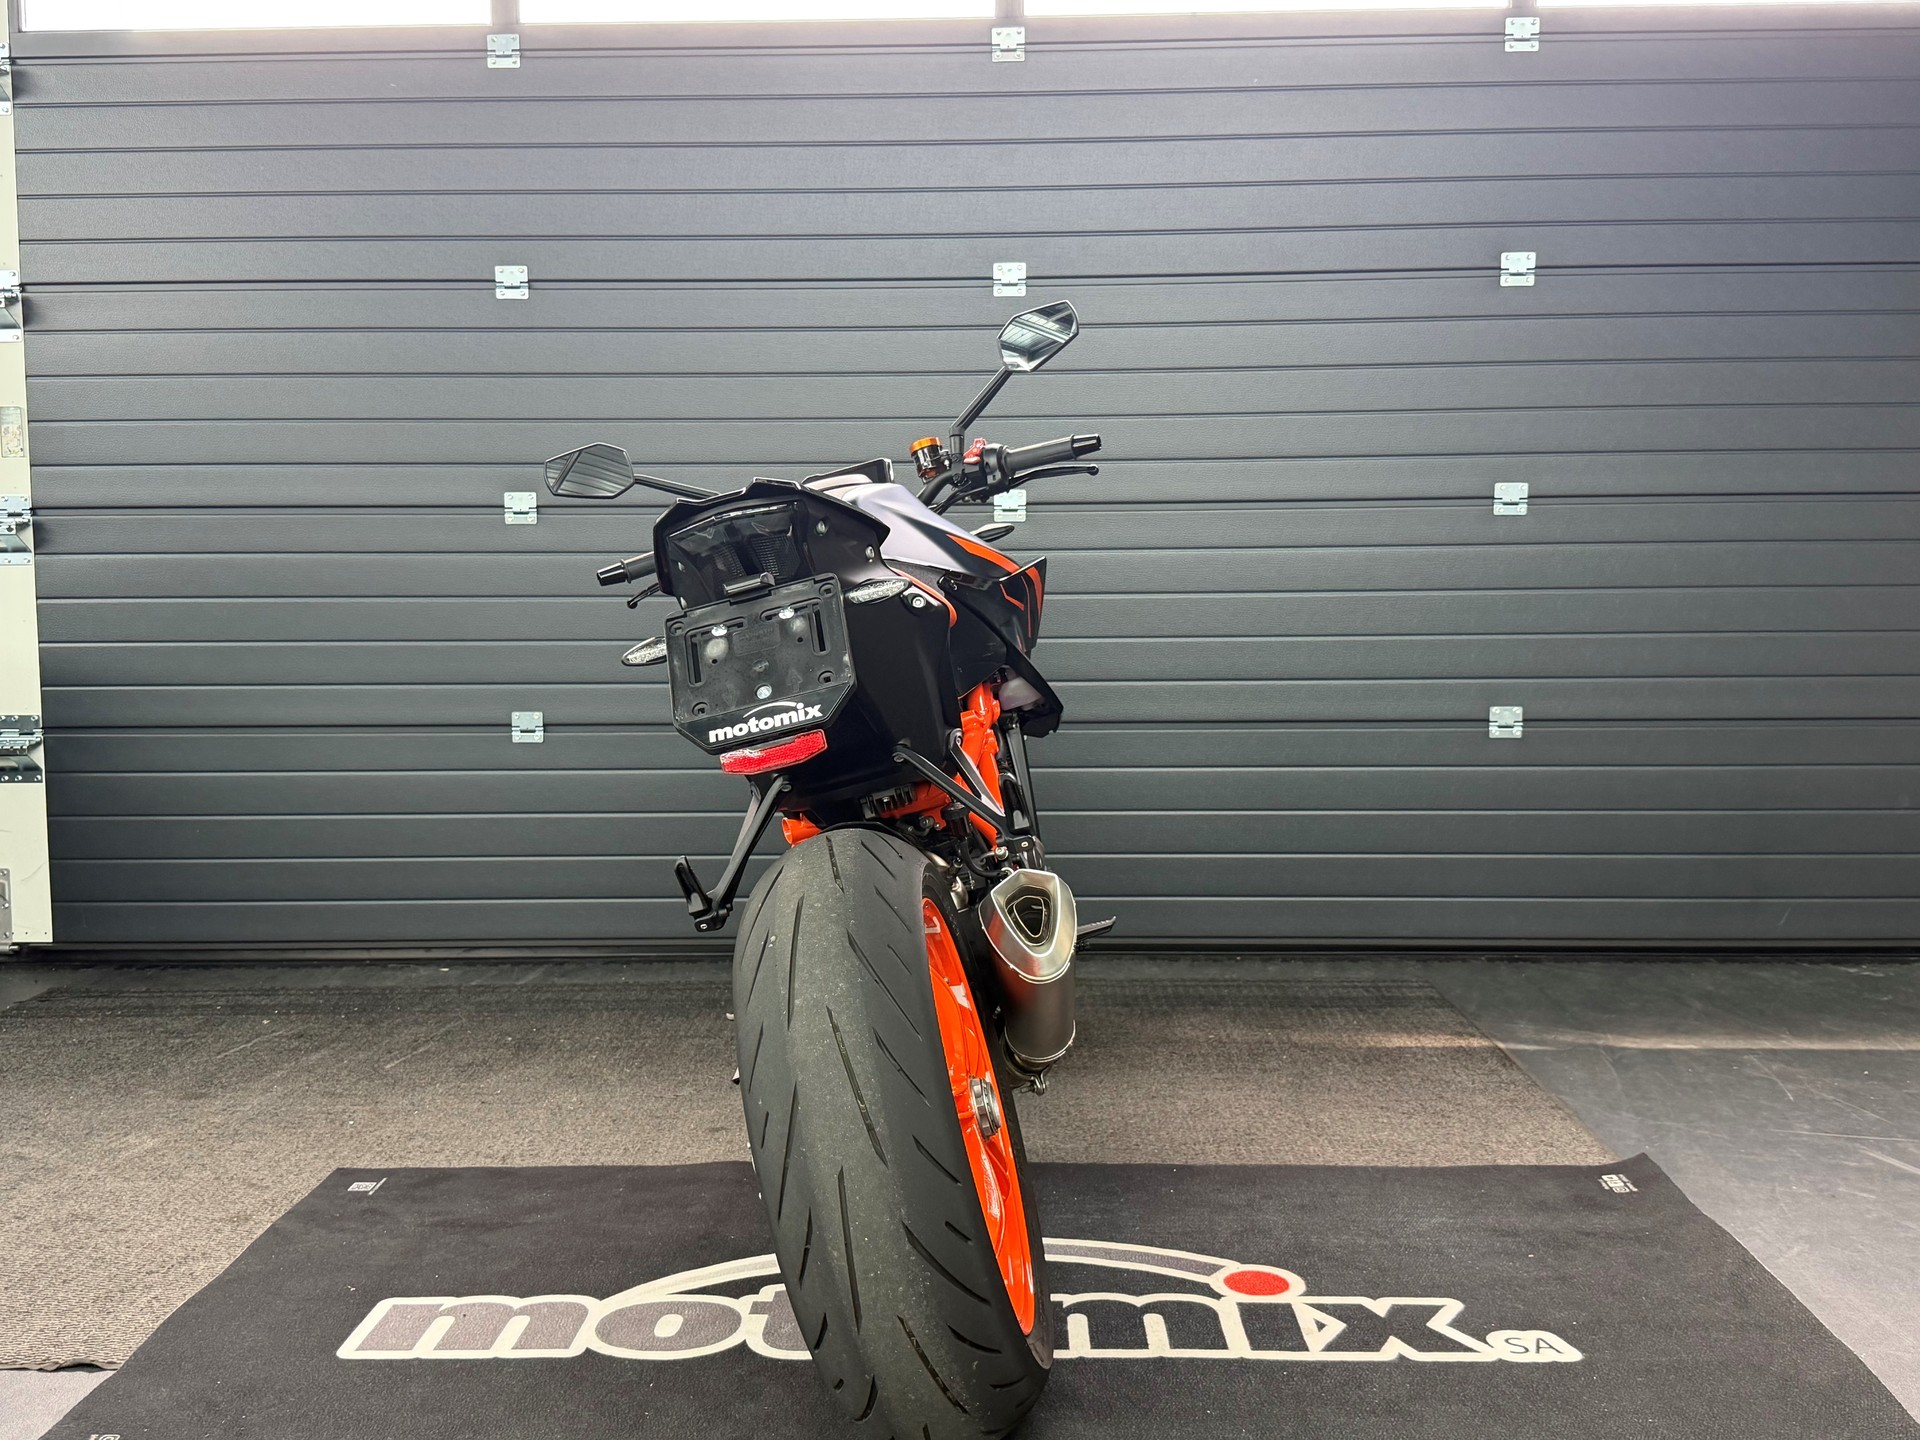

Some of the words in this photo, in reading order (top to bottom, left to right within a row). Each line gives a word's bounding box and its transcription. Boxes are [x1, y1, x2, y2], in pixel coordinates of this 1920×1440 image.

[708, 702, 823, 743] motomix
[338, 1263, 1492, 1361] motmix
[1503, 1336, 1564, 1355] SA
